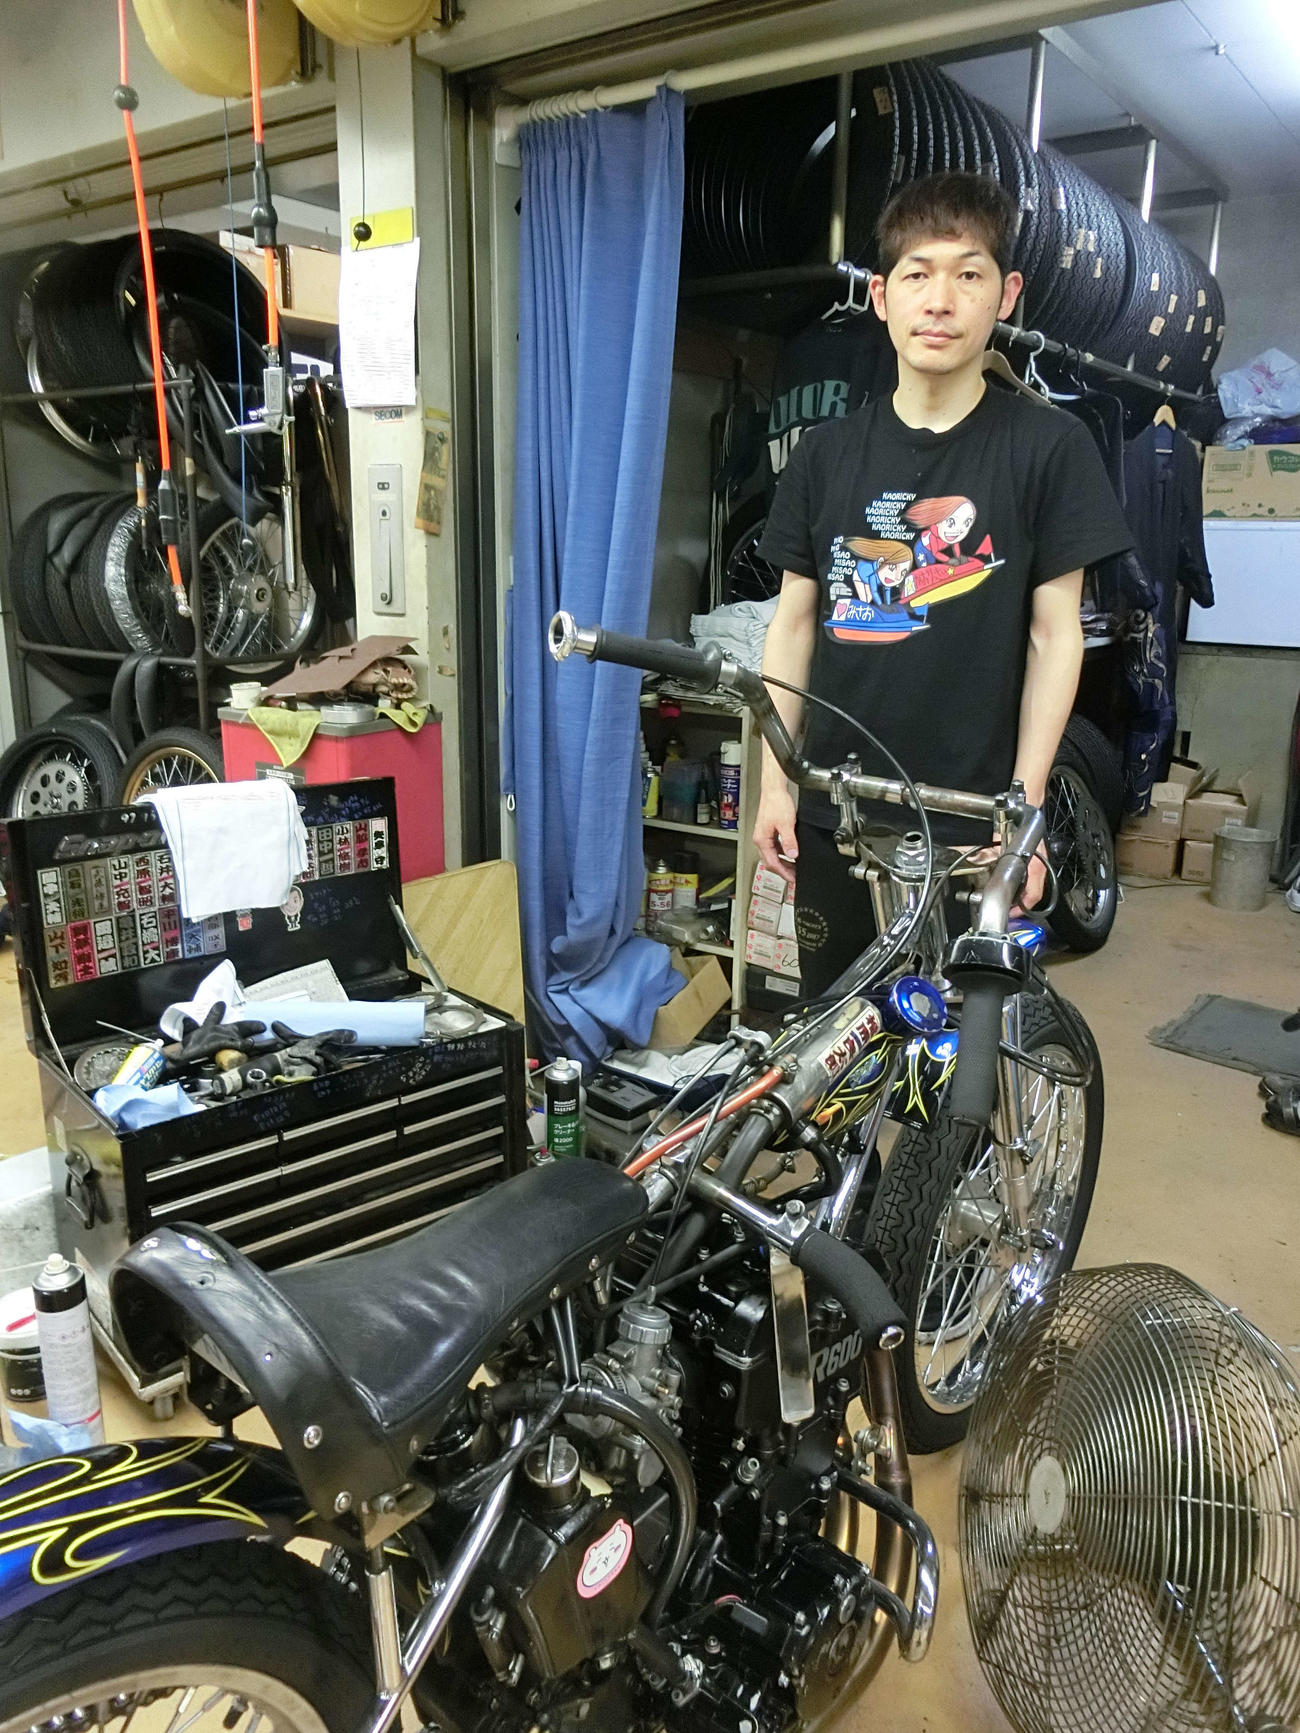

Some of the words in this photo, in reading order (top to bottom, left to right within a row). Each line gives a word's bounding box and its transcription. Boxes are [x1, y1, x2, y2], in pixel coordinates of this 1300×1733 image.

[882, 492, 917, 501] KAORICKY
[872, 500, 907, 510] KAORICKY
[865, 507, 900, 517] KAORICKY
[866, 515, 901, 525] KAORICKY
[872, 523, 907, 532] KAORICKY
[880, 531, 916, 540] KAORICKY
[834, 558, 856, 568] MISAO
[831, 566, 853, 575] MISAO
